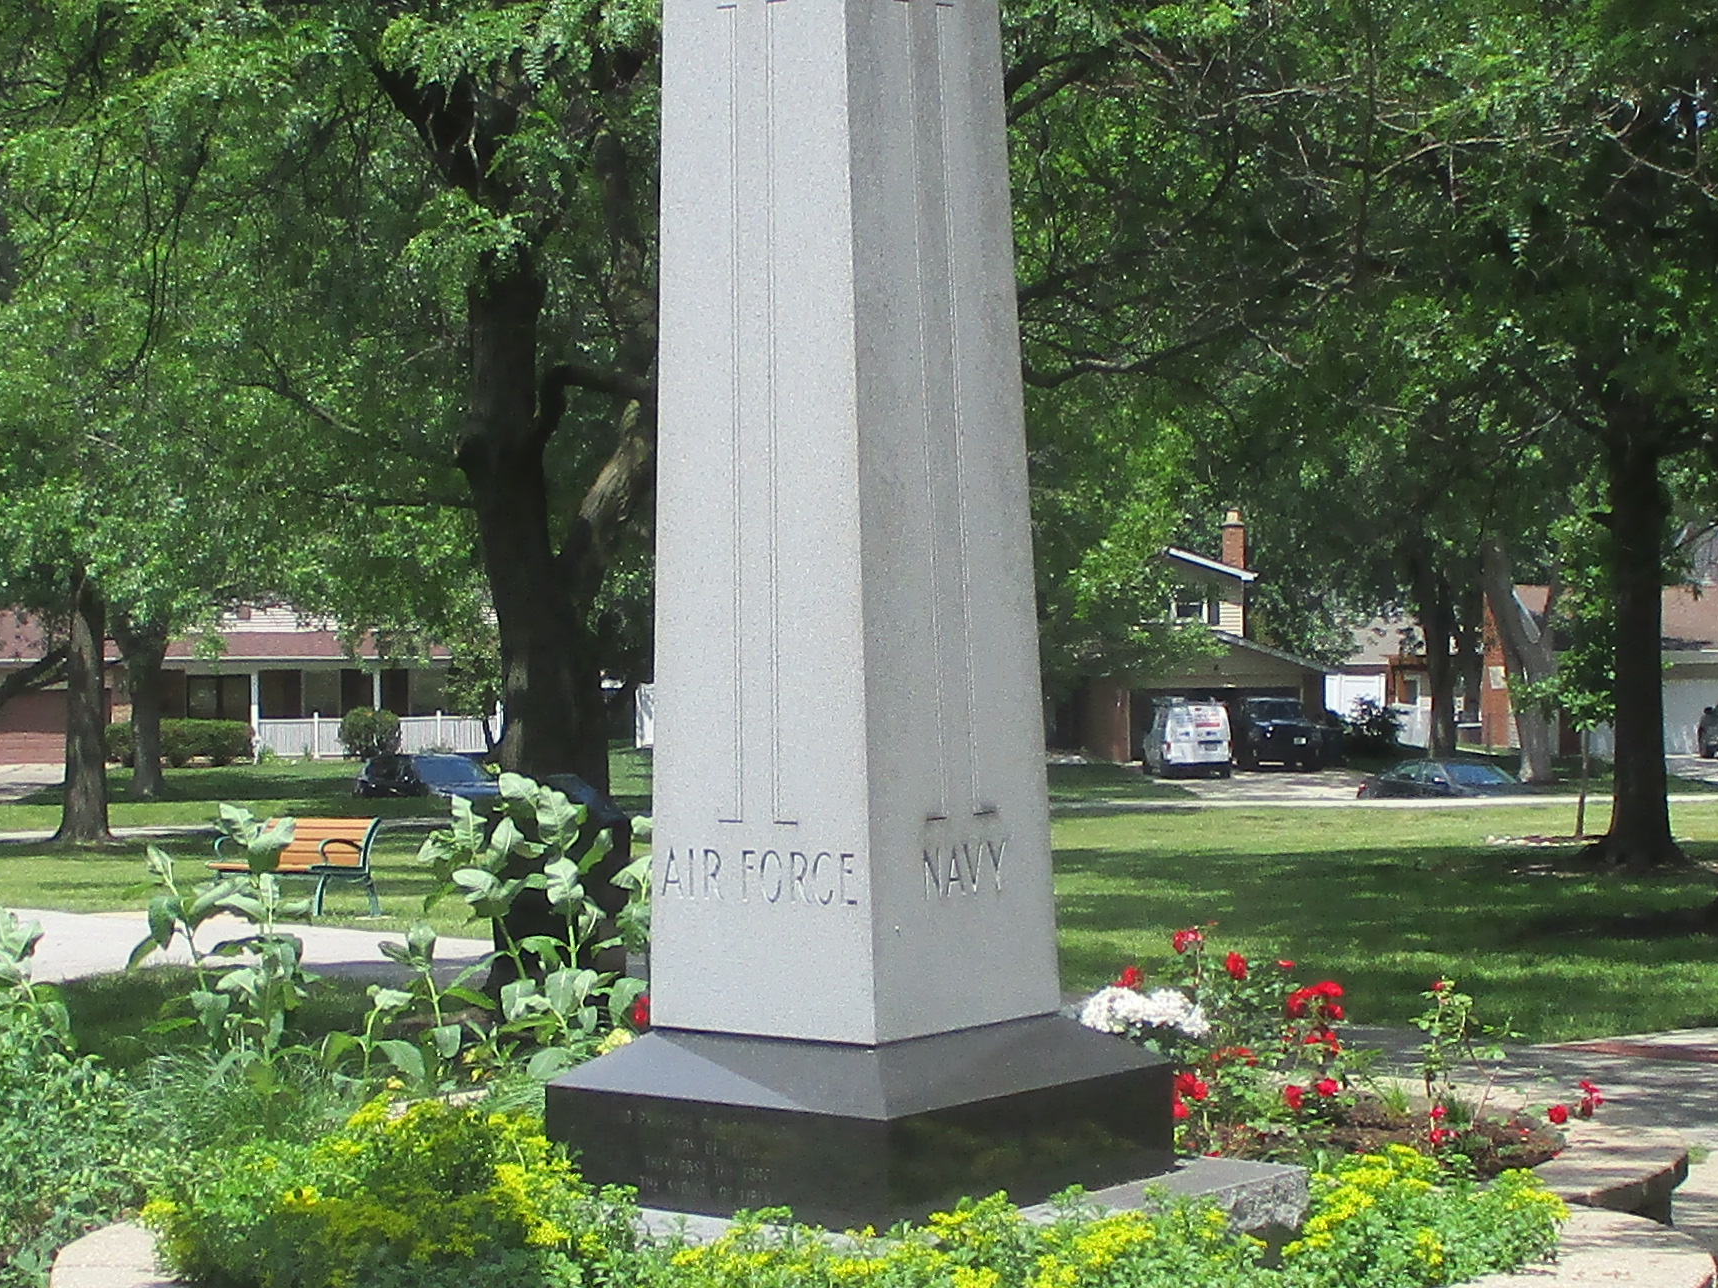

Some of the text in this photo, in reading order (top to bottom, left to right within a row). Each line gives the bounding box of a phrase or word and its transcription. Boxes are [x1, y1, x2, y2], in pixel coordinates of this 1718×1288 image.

[661, 846, 858, 906] AIR FORCE
[921, 838, 1008, 901] NAVY
